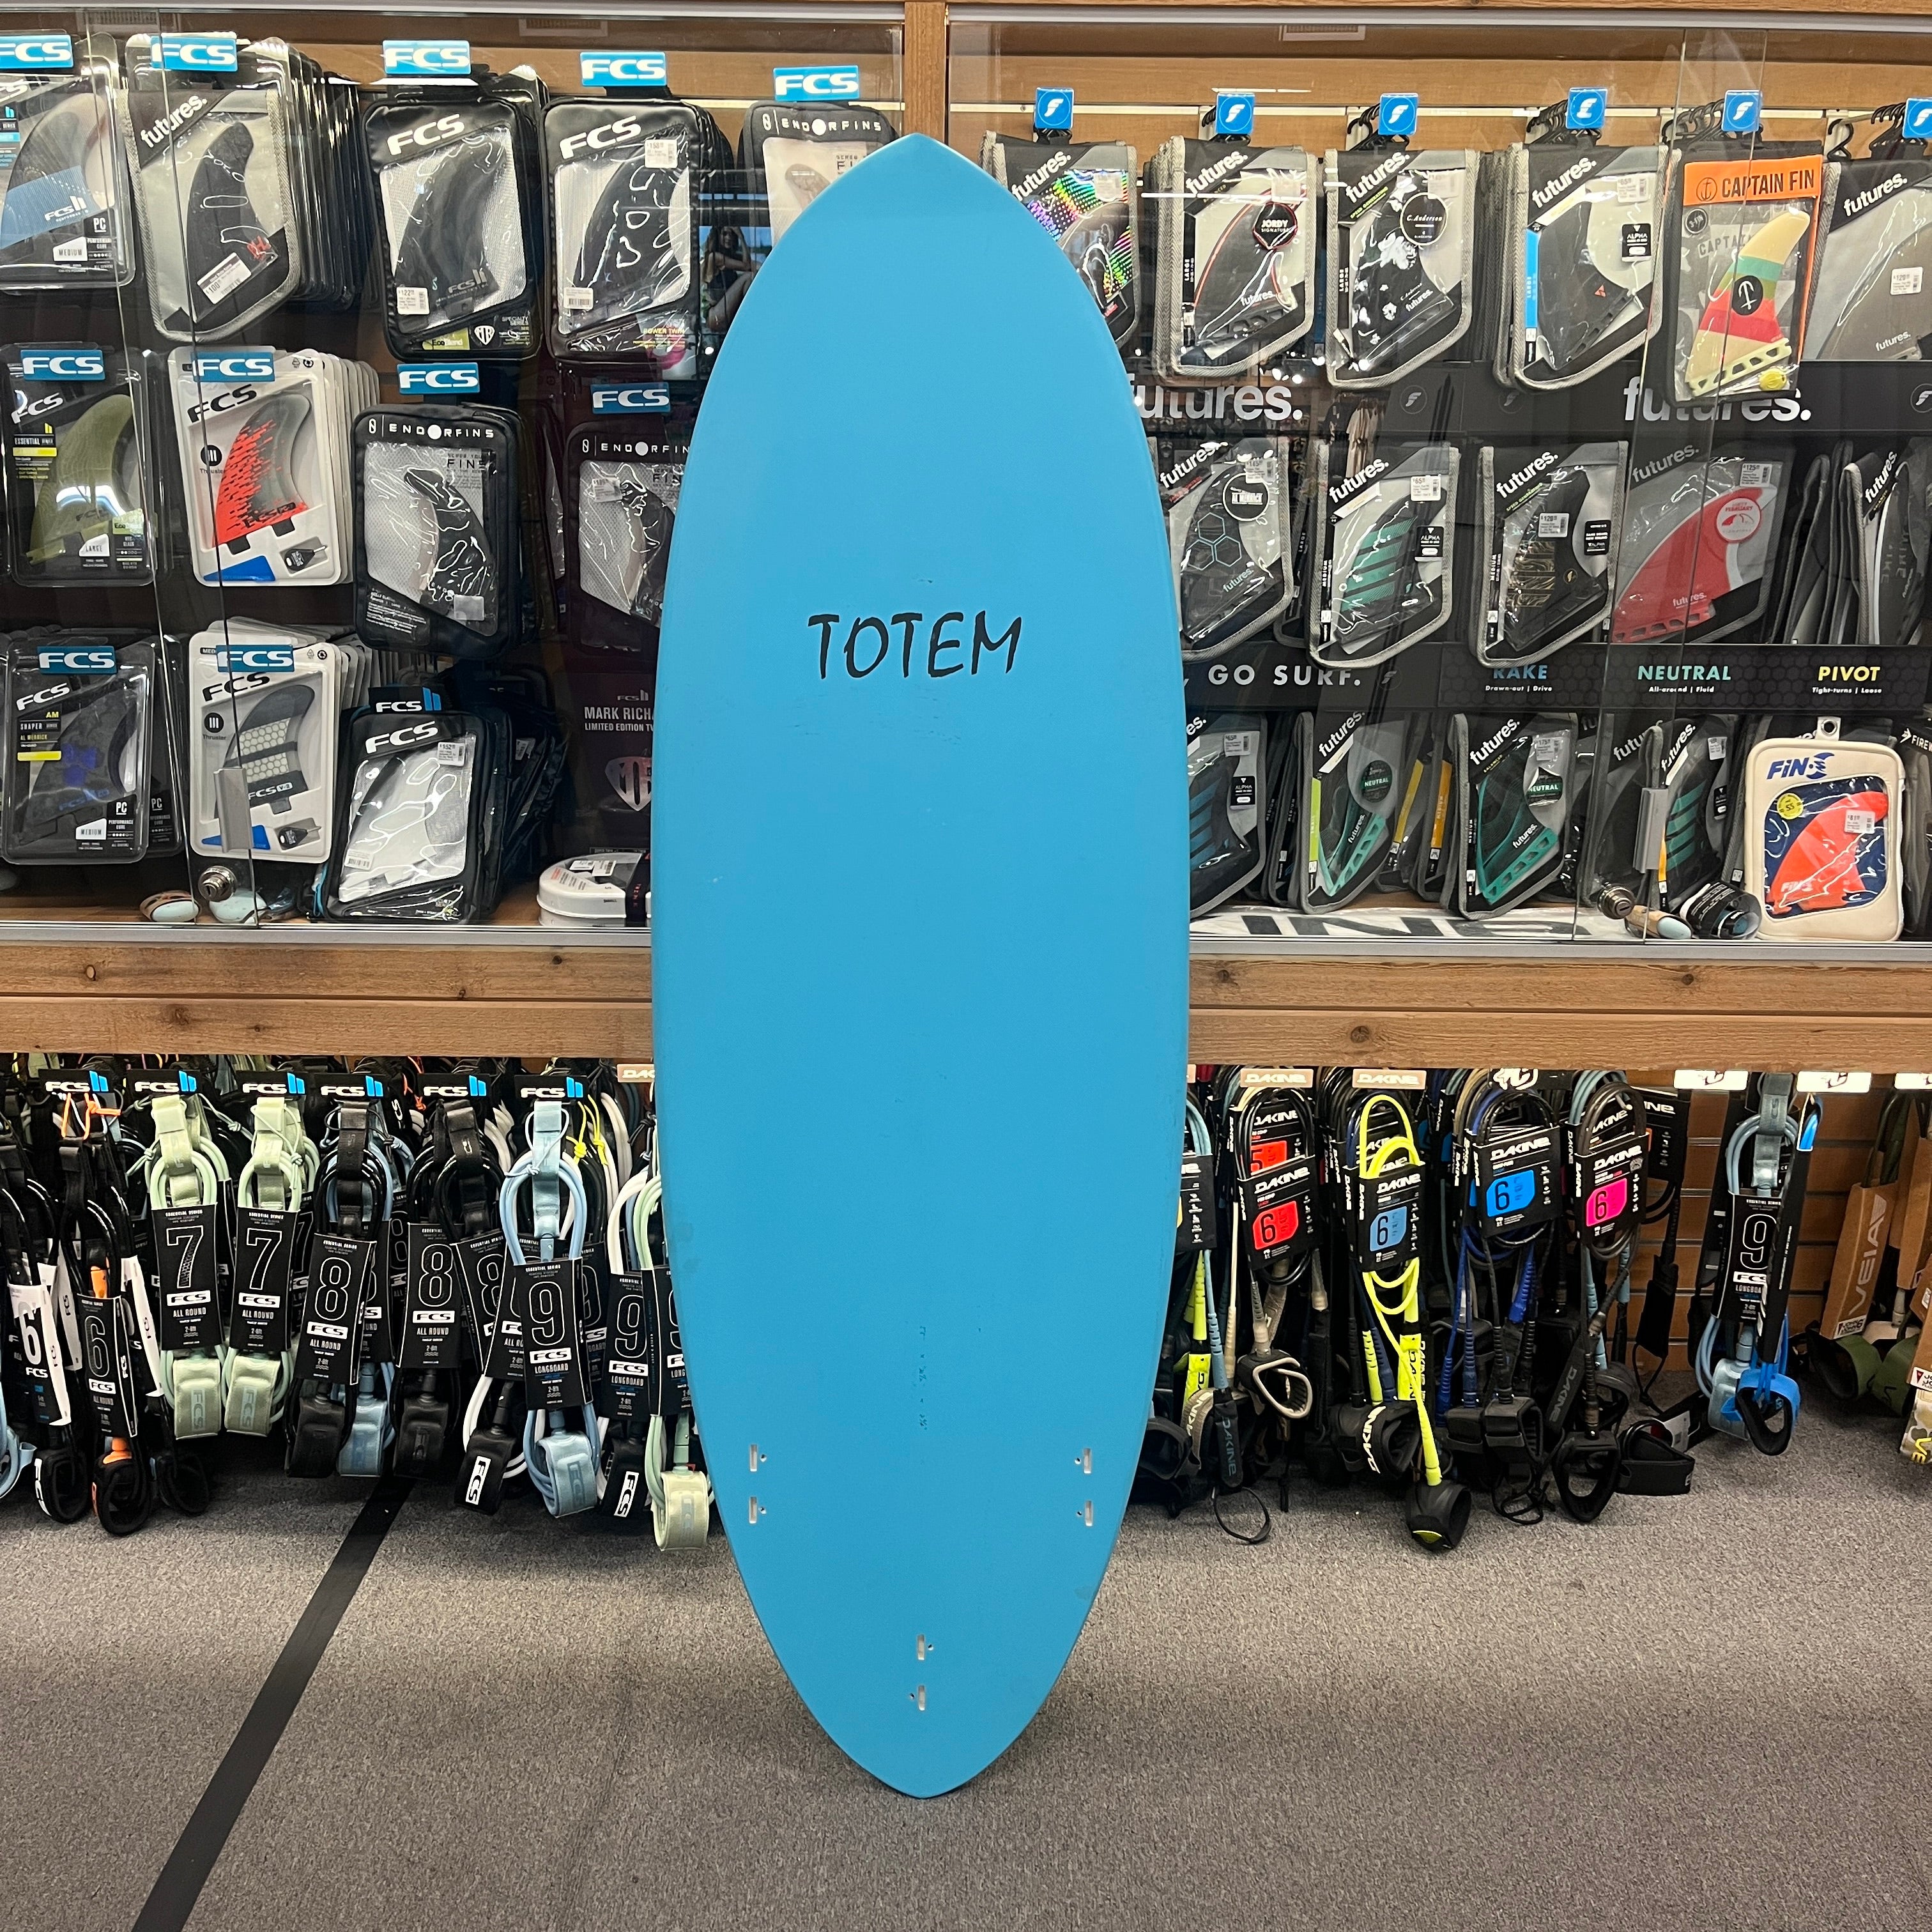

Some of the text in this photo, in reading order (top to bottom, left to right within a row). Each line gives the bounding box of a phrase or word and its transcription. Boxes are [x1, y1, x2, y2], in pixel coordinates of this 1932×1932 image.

[152, 43, 236, 65] FCS
[385, 48, 470, 67] FCS
[581, 59, 666, 79] FCS
[775, 73, 859, 96] FCS
[141, 95, 208, 148] futures.
[387, 114, 465, 155] FCS
[560, 116, 641, 160] FCS
[1011, 151, 1071, 201] futures.
[1186, 151, 1248, 195] futures.
[1346, 152, 1410, 203] futures.
[1531, 157, 1597, 208] futures.
[1722, 169, 1814, 198] CAPTAIN FIN
[1843, 173, 1908, 217] futures.
[93, 217, 107, 231] PC
[1262, 219, 1289, 228] JORDY
[1875, 330, 1912, 351] futures.
[22, 357, 103, 374] FCS
[192, 358, 273, 376] FCS
[399, 370, 478, 388] FCS
[187, 384, 257, 423] FCS
[592, 389, 670, 408] FCS
[389, 423, 494, 438] ENDORFINS
[601, 441, 690, 456] ENDORFIN
[1632, 444, 1700, 483] futures.
[1329, 458, 1390, 503] futures.
[1496, 451, 1559, 498] futures.
[1865, 451, 1897, 503] futures.
[1222, 567, 1255, 592] futures.
[808, 610, 1022, 679] TOTEM
[39, 652, 115, 669] FCS
[217, 651, 294, 667] FCS
[1208, 664, 1361, 686] GO SURF.
[1637, 666, 1731, 680] NEUTRAL
[1818, 666, 1881, 682] PIVOT
[17, 683, 70, 710] FCS
[203, 671, 270, 702] FCS
[1812, 686, 1852, 694] Tight-turns
[376, 701, 422, 712] FCS
[584, 707, 654, 721] MARK RICH
[365, 721, 438, 754] FCS
[585, 723, 644, 732] LIMITED EDITION
[1319, 710, 1366, 758] futures.
[1469, 718, 1521, 765] futures.
[1364, 778, 1389, 787] NEUTRAL
[116, 801, 128, 813] PC
[151, 798, 163, 809] PC
[1348, 815, 1366, 845] futures.
[1513, 824, 1538, 848] futures.
[45, 1081, 91, 1092] FCS
[135, 1081, 180, 1092] FCS
[242, 1084, 288, 1094] FCS
[1244, 1073, 1307, 1084] DAKINE
[1356, 1074, 1420, 1085] DAKINE
[321, 1085, 365, 1096] FCS
[424, 1086, 468, 1097] FCS
[521, 1087, 565, 1098] FCS
[1490, 1137, 1551, 1162] DAKINE
[1593, 1145, 1643, 1171] DAKINE
[1254, 1167, 1310, 1194] DAKINE
[1376, 1174, 1422, 1194] DAKINE
[1494, 1180, 1510, 1211] 6
[1595, 1190, 1607, 1220] 6
[1260, 1213, 1276, 1243] 6
[1376, 1215, 1389, 1246] 6
[1740, 1213, 1777, 1270] 9
[166, 1225, 204, 1289] 7
[246, 1227, 282, 1291] 7
[418, 1243, 455, 1307] 8
[171, 1293, 207, 1303] FCS
[314, 1257, 351, 1321] 8
[1736, 1285, 1761, 1294] LONGBOA
[242, 1296, 277, 1305] FCS
[172, 1309, 183, 1317] ALL
[241, 1309, 253, 1317] ALL
[528, 1281, 565, 1346] 9
[310, 1326, 344, 1337] FCS
[417, 1328, 427, 1336] ALL
[615, 1294, 646, 1358] 9
[84, 1315, 110, 1378] 6
[309, 1338, 320, 1347] ALL
[533, 1351, 568, 1361] FCS
[26, 1367, 49, 1379] FCS
[534, 1363, 569, 1374] LONGBOARD
[612, 1363, 645, 1374] FCS
[91, 1382, 113, 1392] FCS
[611, 1375, 645, 1386] LONGBOARD
[1220, 1414, 1238, 1477] DAKINE
[466, 1459, 486, 1503] FCS
[617, 1473, 638, 1516] FCS
